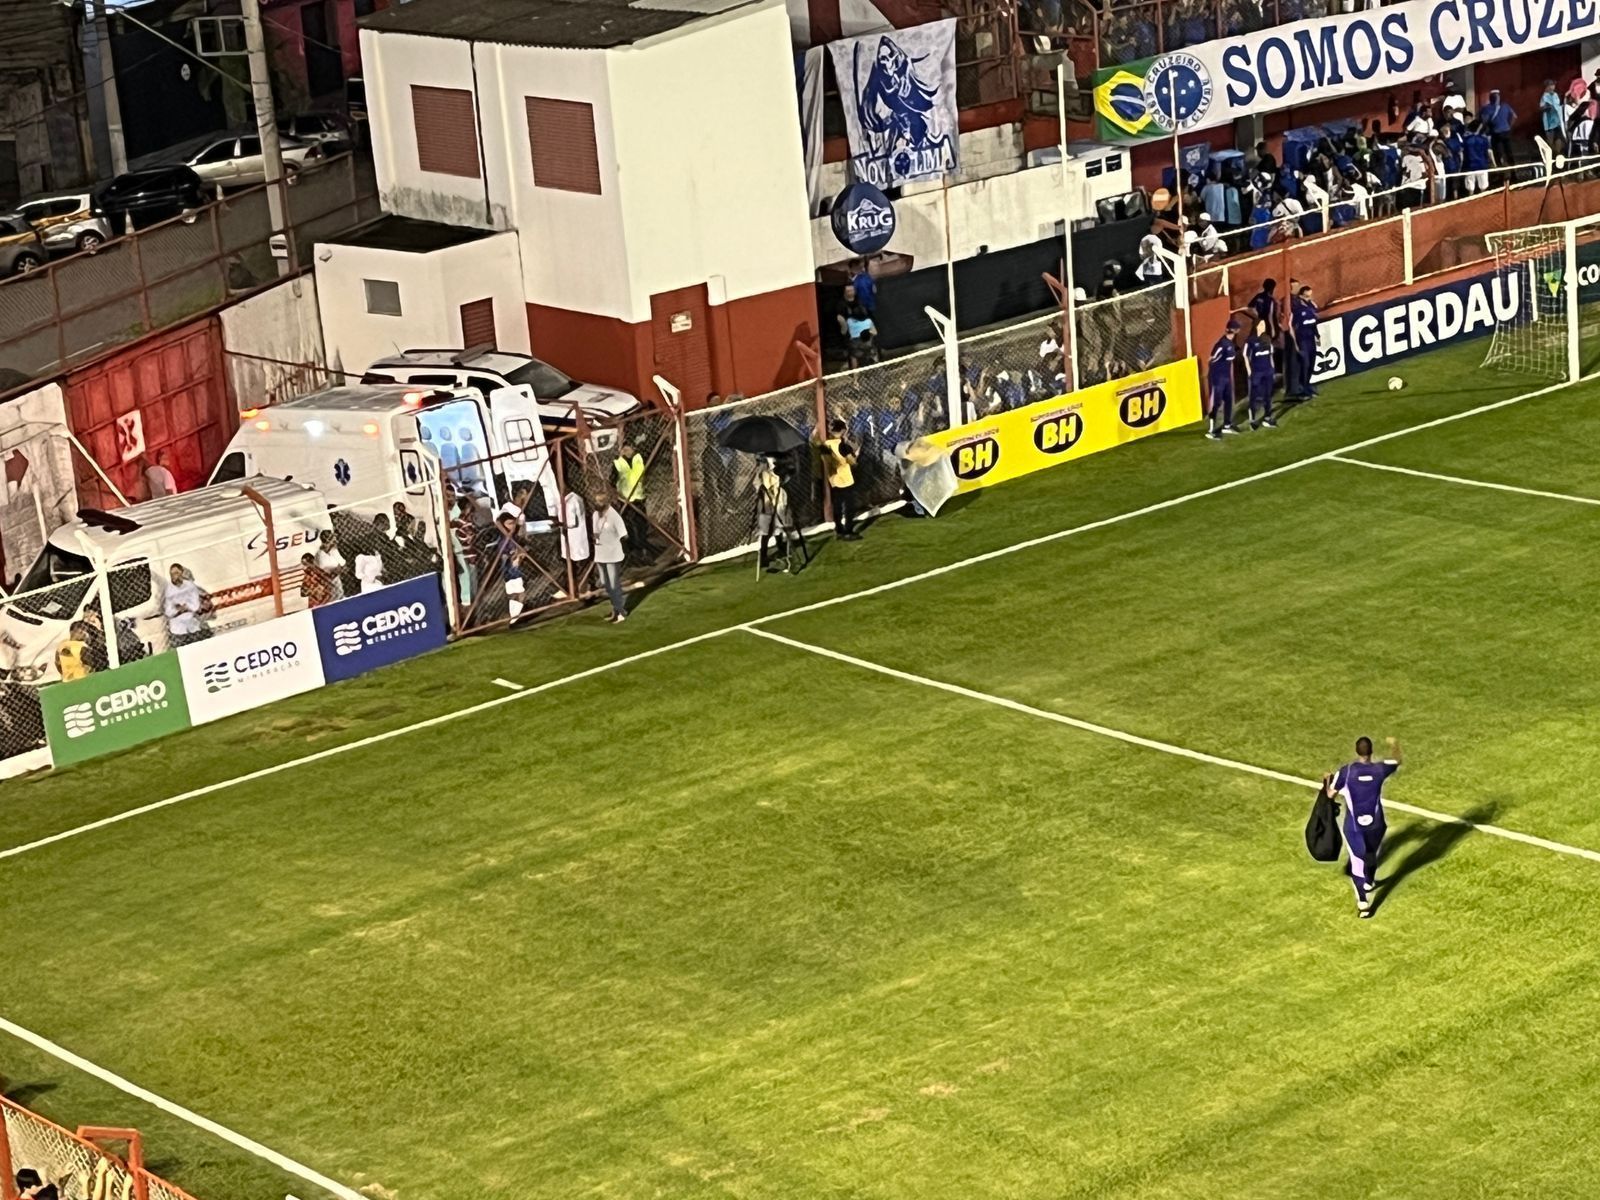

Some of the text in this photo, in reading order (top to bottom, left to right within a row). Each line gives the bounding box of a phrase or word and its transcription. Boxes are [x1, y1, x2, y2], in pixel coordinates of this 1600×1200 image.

[1147, 55, 1202, 84] CRUZEIRO
[1222, 0, 1600, 108] SOMOS CRUZE
[846, 207, 893, 232] KRUG
[1350, 271, 1520, 363] GERDAU
[1127, 390, 1160, 423] BH
[1042, 414, 1077, 450] BH
[958, 440, 993, 475] BH
[362, 602, 426, 636] CEDRO
[234, 642, 297, 673] CEDRO
[95, 679, 166, 717] CEDRO
